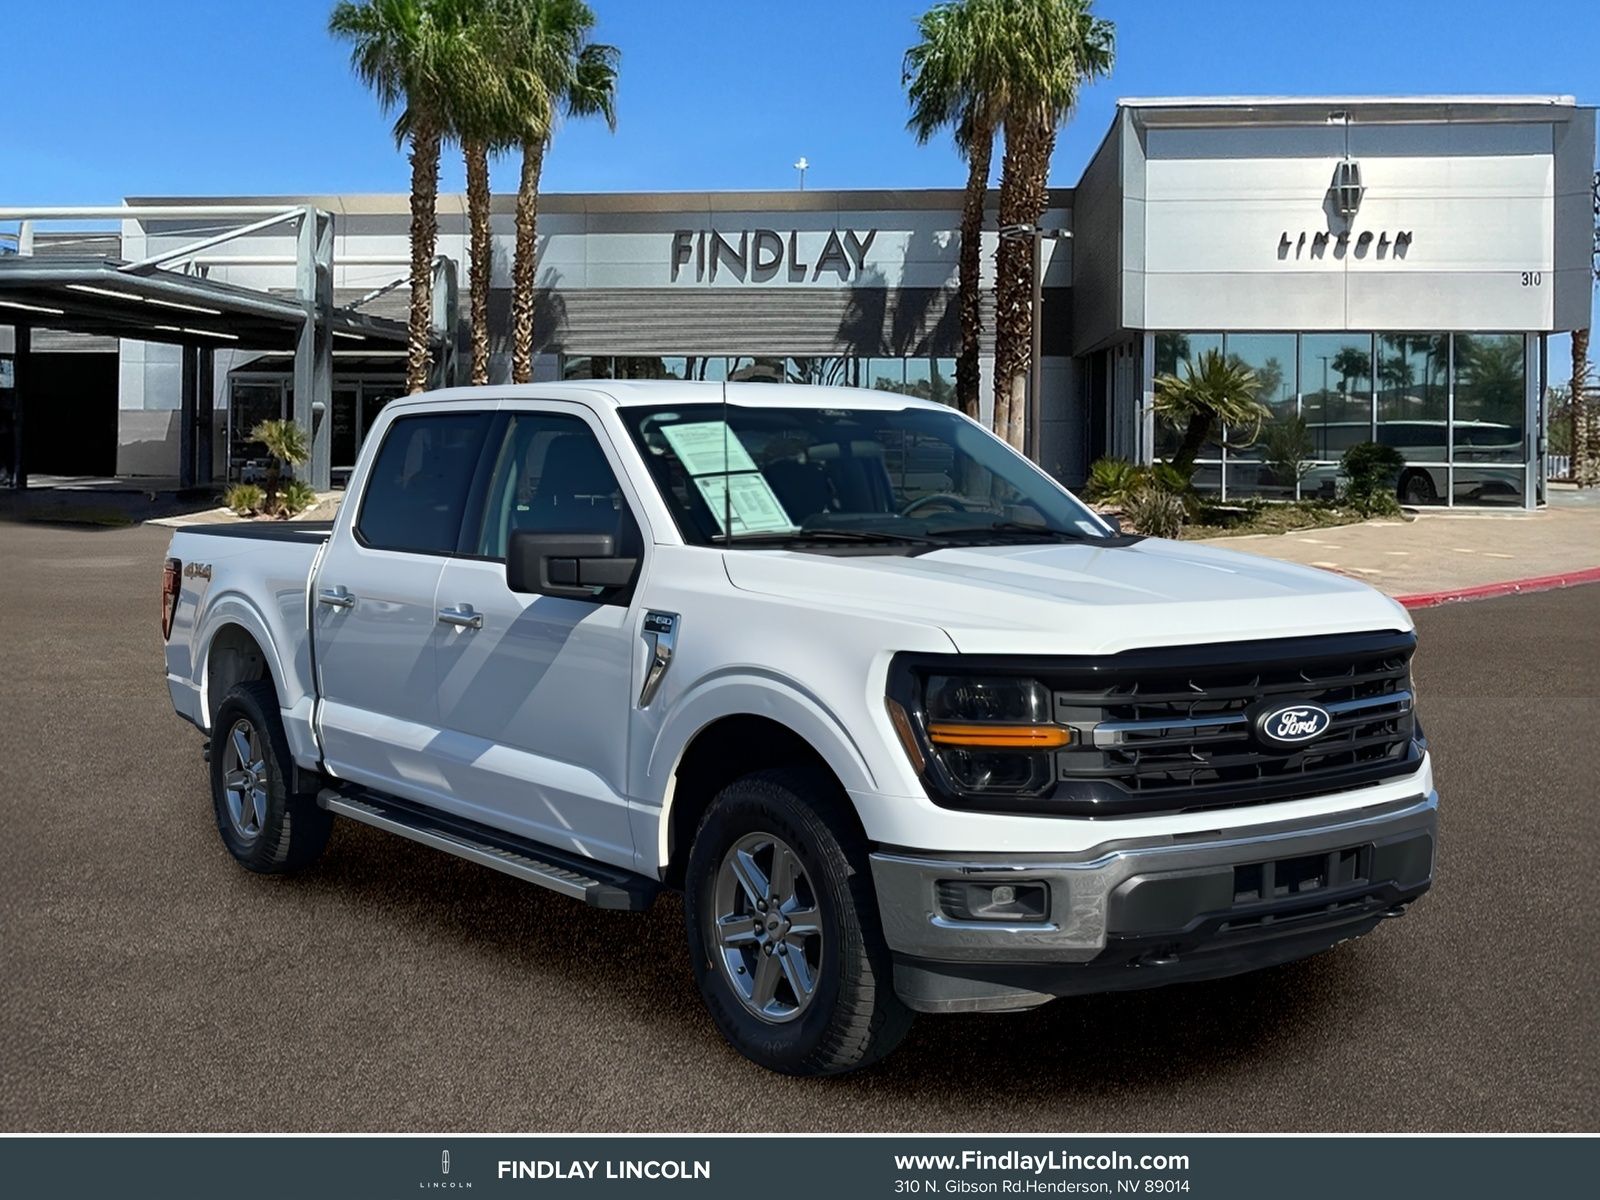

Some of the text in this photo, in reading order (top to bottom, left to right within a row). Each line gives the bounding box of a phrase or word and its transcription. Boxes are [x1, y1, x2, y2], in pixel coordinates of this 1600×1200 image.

[671, 229, 877, 283] FINDLAY
[1278, 231, 1413, 260] LINCOLN
[1521, 271, 1542, 287] 310
[1277, 710, 1318, 737] Ford
